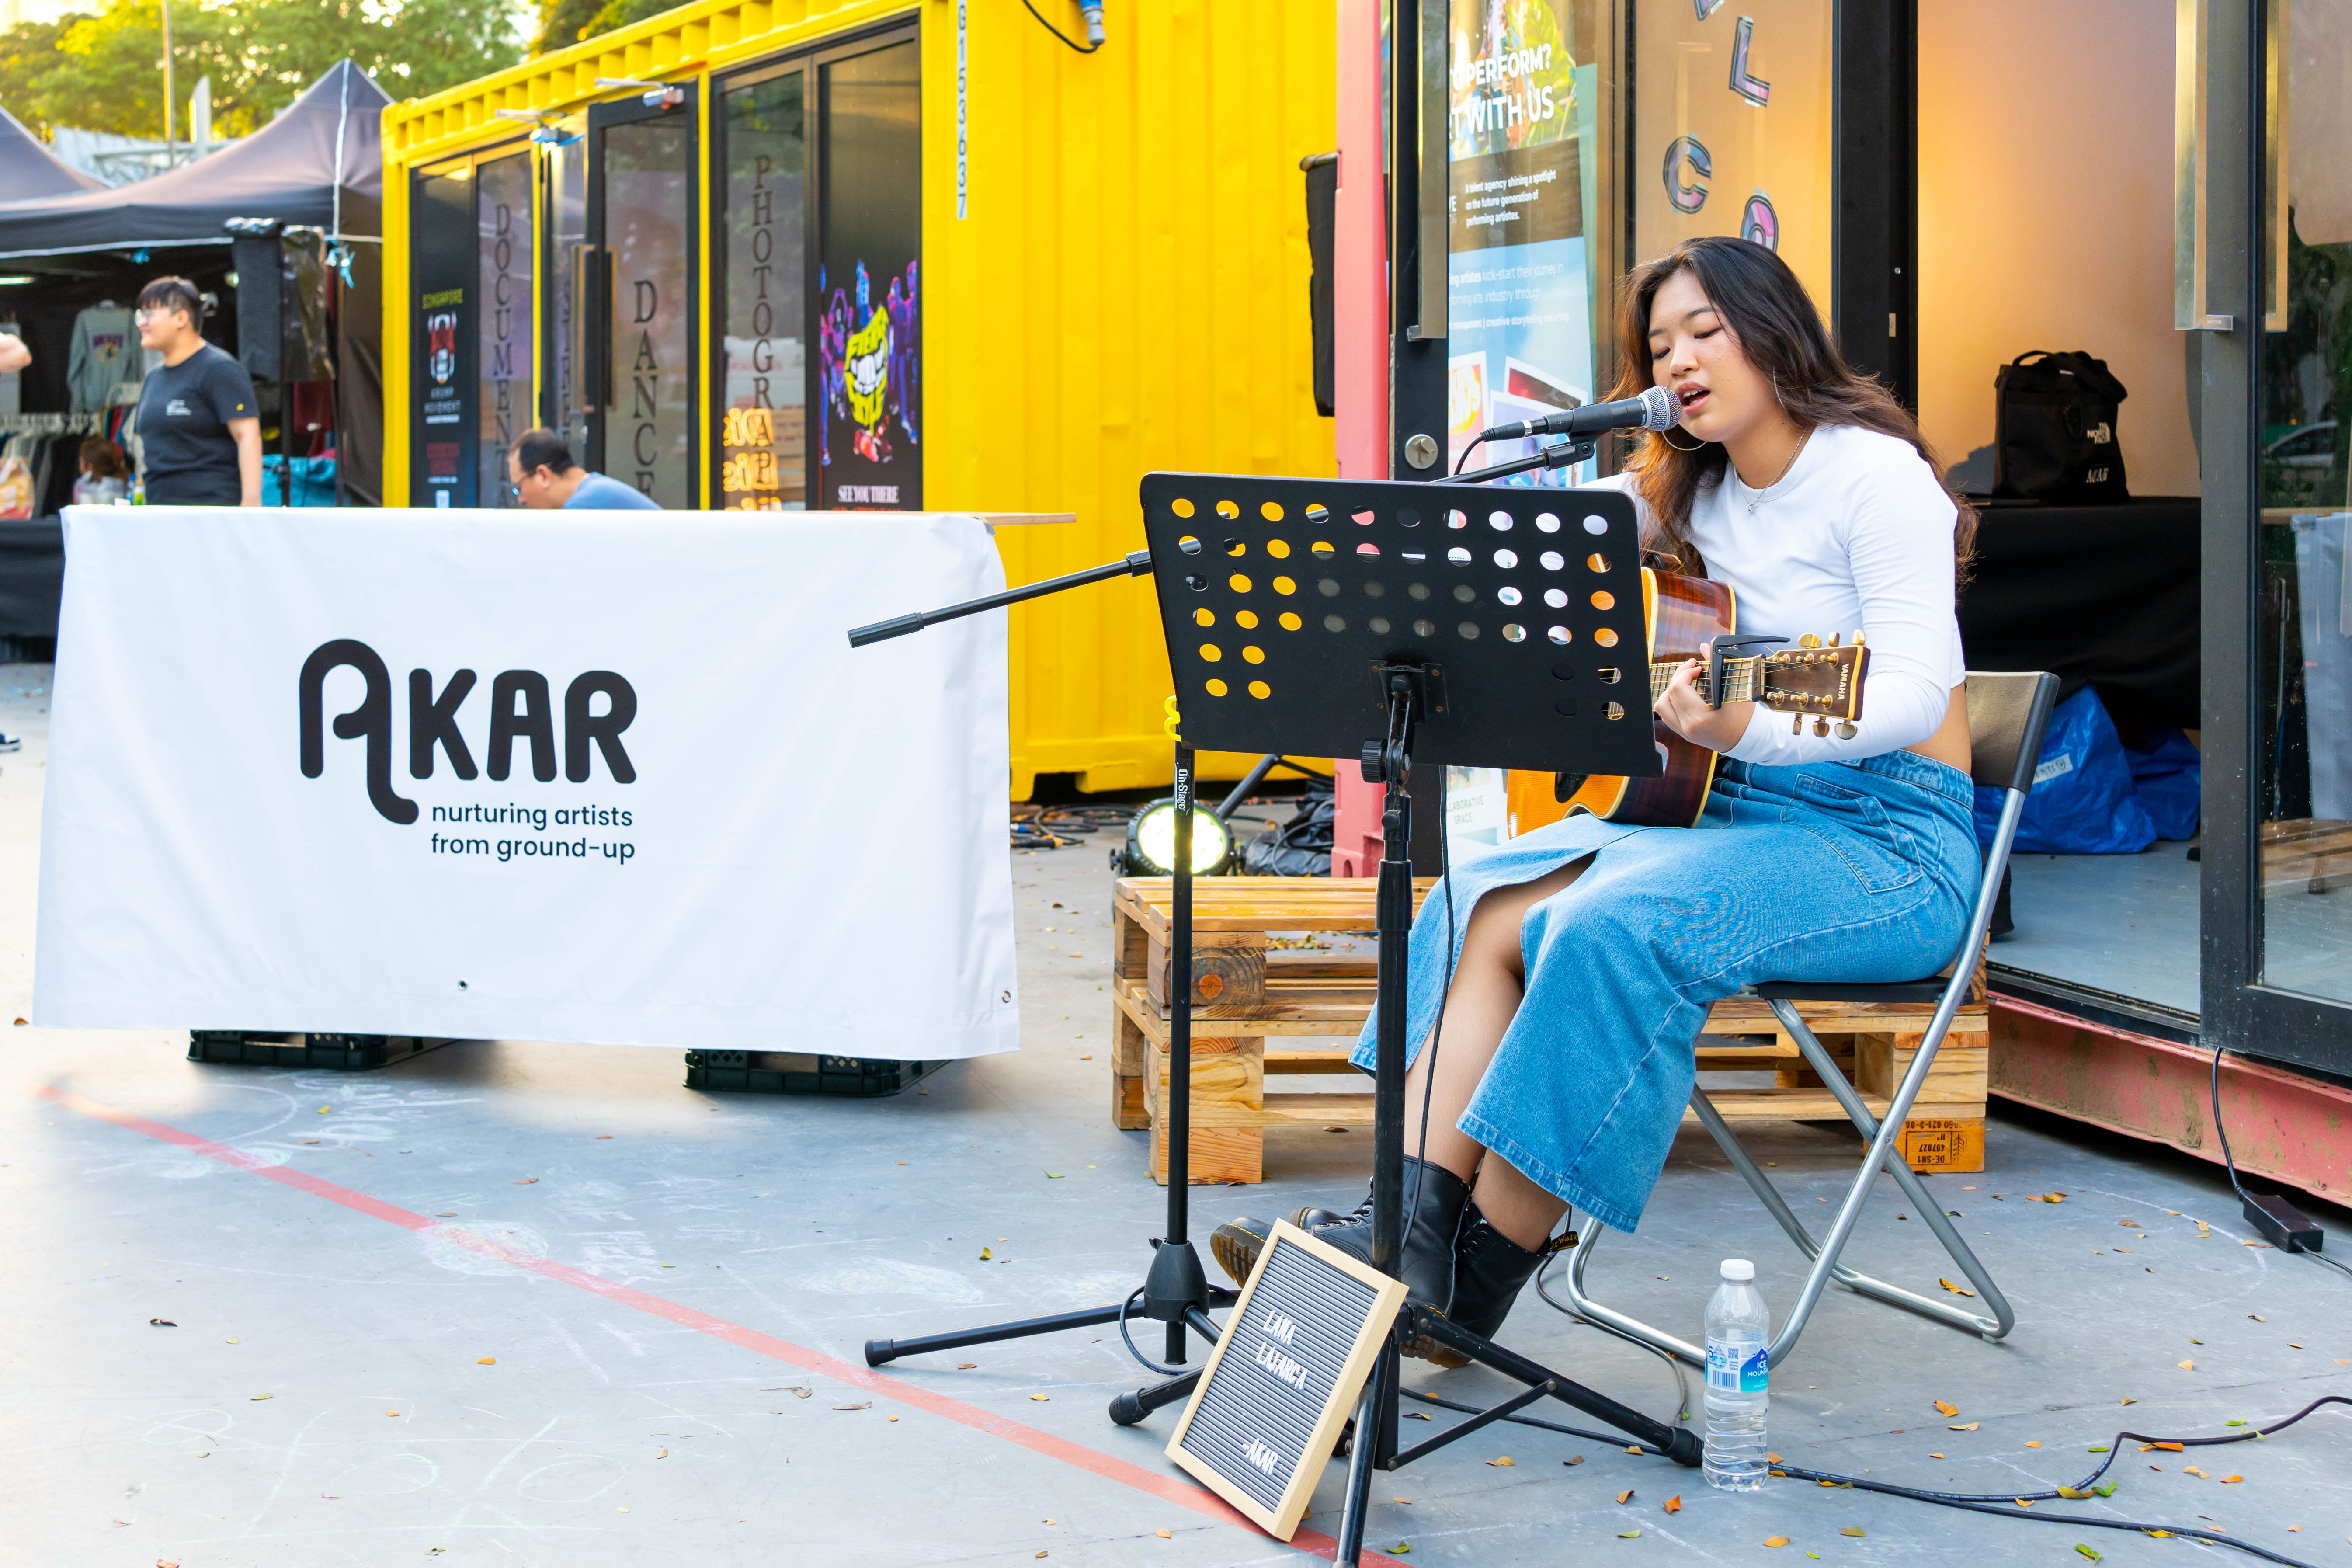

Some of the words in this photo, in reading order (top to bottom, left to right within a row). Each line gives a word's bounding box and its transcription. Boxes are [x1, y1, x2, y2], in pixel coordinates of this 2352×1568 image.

[1466, 43, 1552, 88] PERFORM?
[1466, 92, 1522, 135] WITH
[1527, 85, 1554, 123] US
[1484, 180, 1507, 192] agency
[1508, 174, 1529, 187] shining
[1533, 169, 1556, 184] spotlight
[1472, 198, 1481, 209] the
[1481, 196, 1500, 208] future
[1501, 191, 1532, 207] generation
[1532, 188, 1539, 200] of
[1466, 213, 1494, 229] performing
[1482, 267, 1515, 282] kick-start
[1516, 264, 1532, 278] their
[1532, 263, 1556, 279] journey
[1557, 261, 1563, 274] in
[1484, 289, 1514, 303] industry
[1515, 285, 1542, 301] through
[1486, 316, 1510, 327] creative
[1511, 315, 1543, 326] storytelling
[1837, 663, 1849, 700] YAMAHA
[299, 639, 637, 824] AKAR
[432, 803, 547, 831] nurturing
[555, 805, 633, 827] artists
[431, 833, 489, 855] from
[497, 837, 635, 865] ground-up
[1263, 1310, 1296, 1345] LANA
[1708, 1346, 1713, 1358] 6
[1757, 1359, 1767, 1369] ICE
